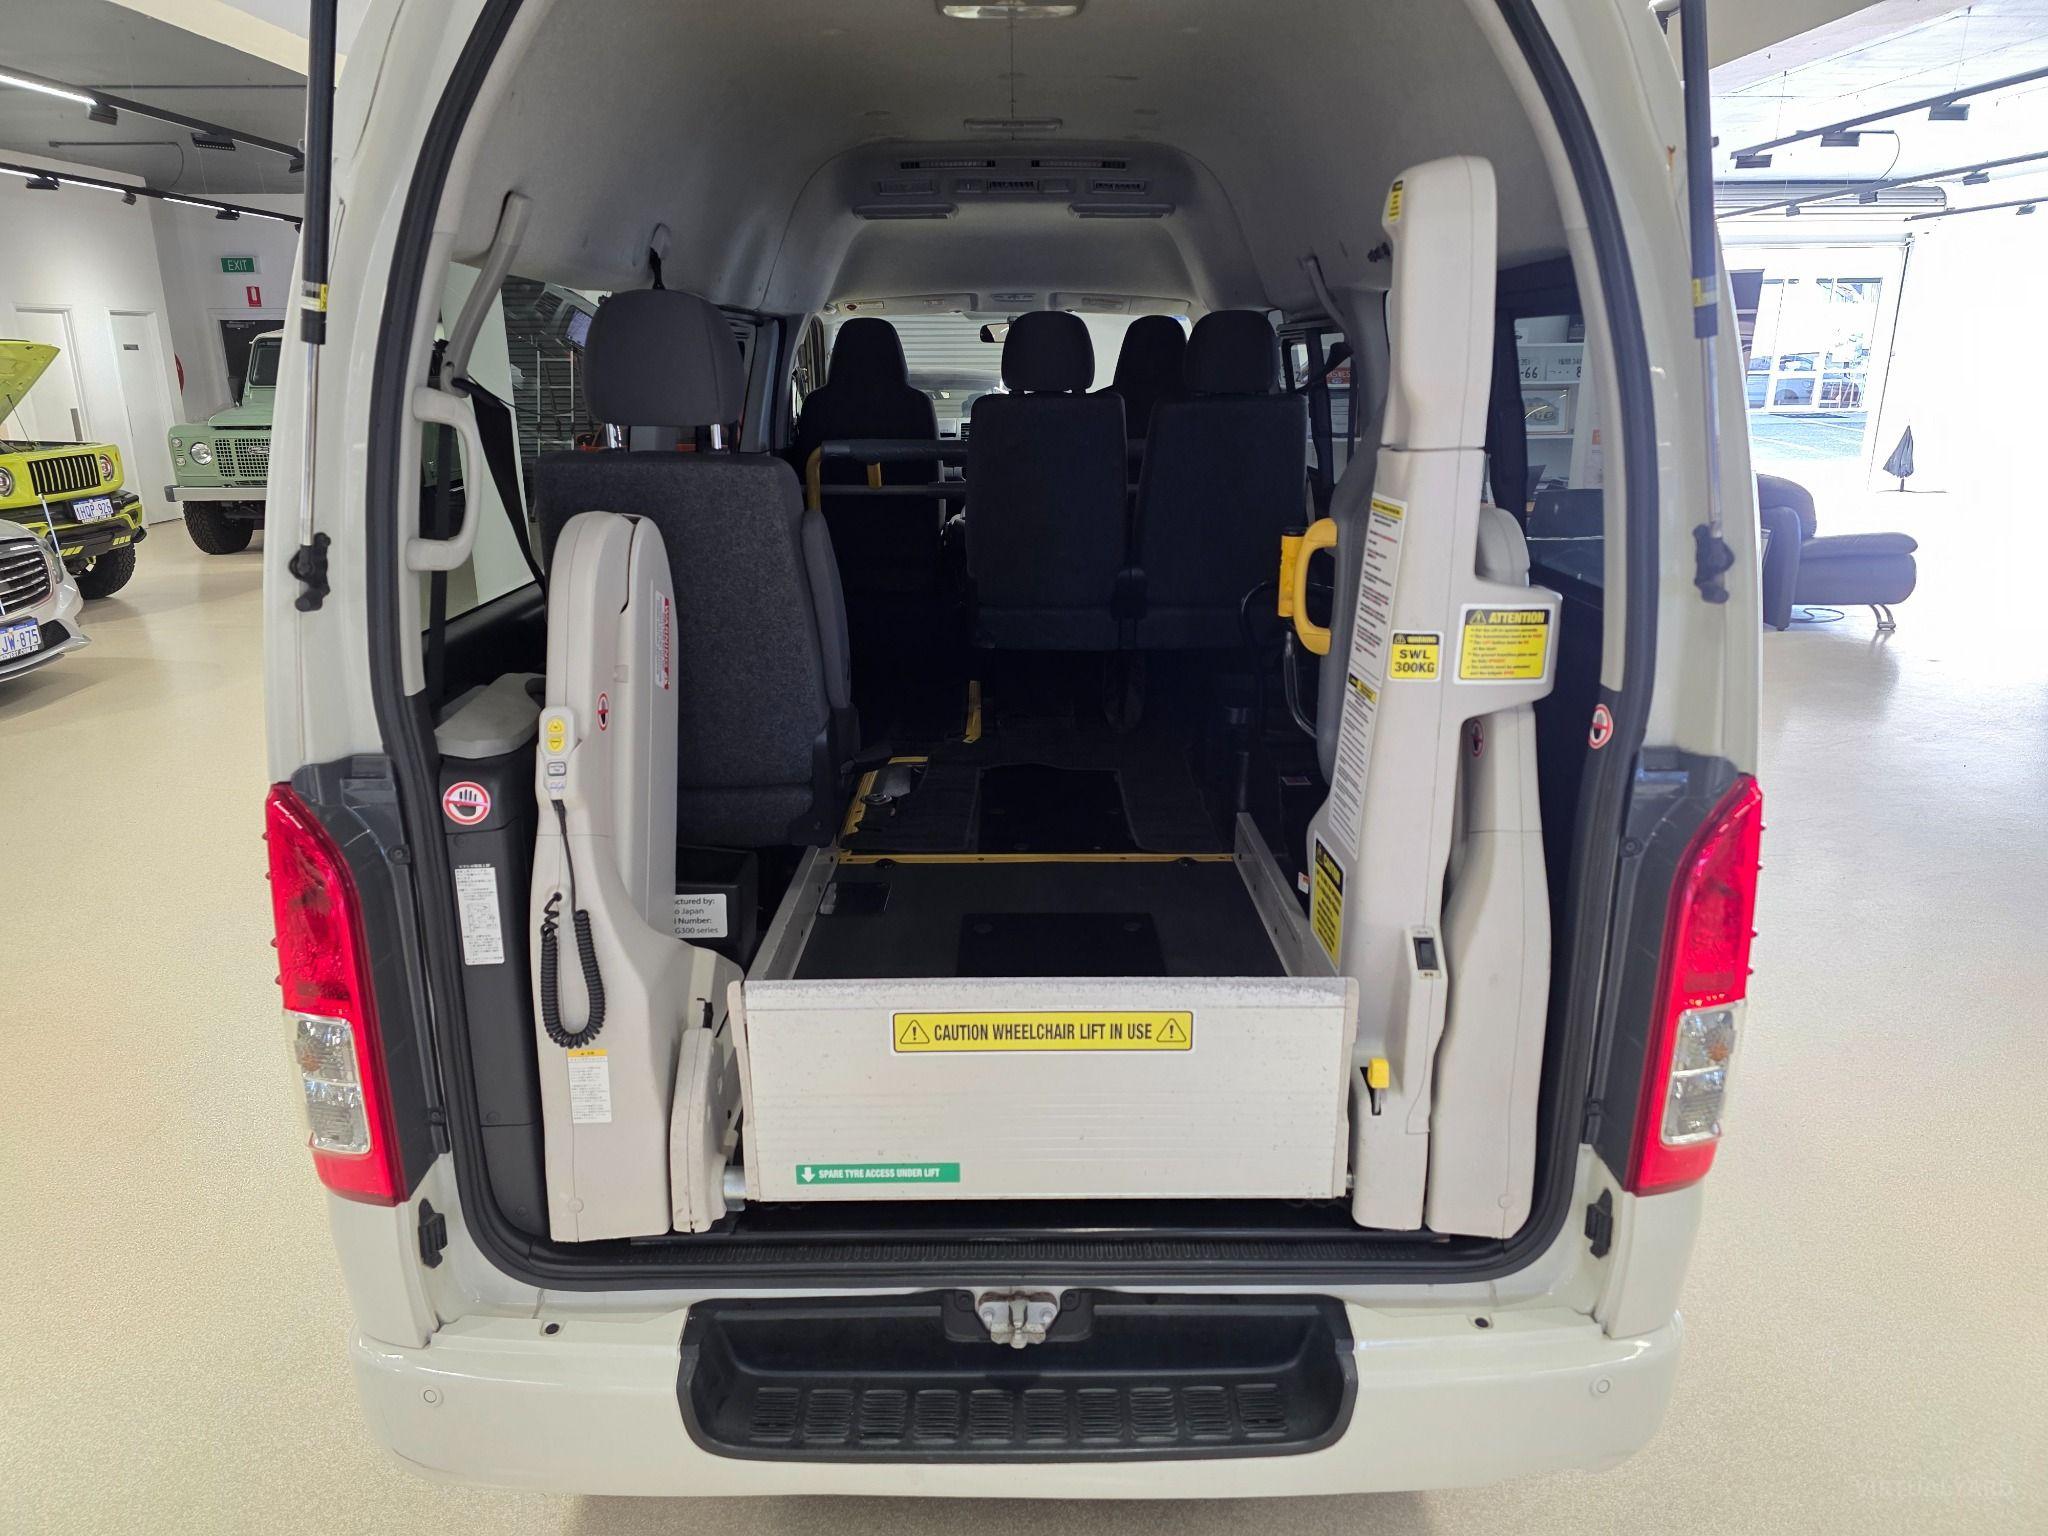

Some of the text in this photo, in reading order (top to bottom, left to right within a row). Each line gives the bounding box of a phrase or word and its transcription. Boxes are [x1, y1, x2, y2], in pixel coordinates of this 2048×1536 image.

[227, 259, 247, 271] EXIT
[1488, 611, 1545, 624] ATTENTION
[19, 629, 39, 647] 875
[1399, 649, 1430, 659] SWL
[1394, 662, 1435, 673] 300KG
[703, 897, 715, 906] by:
[681, 908, 704, 916] Japan
[678, 917, 712, 925] Number:
[934, 1023, 1152, 1041] CAUTION WHEELCHAIR LIFT IN USE
[818, 1168, 940, 1179] SPARE TYRE ACCESS UNDER LIFT
